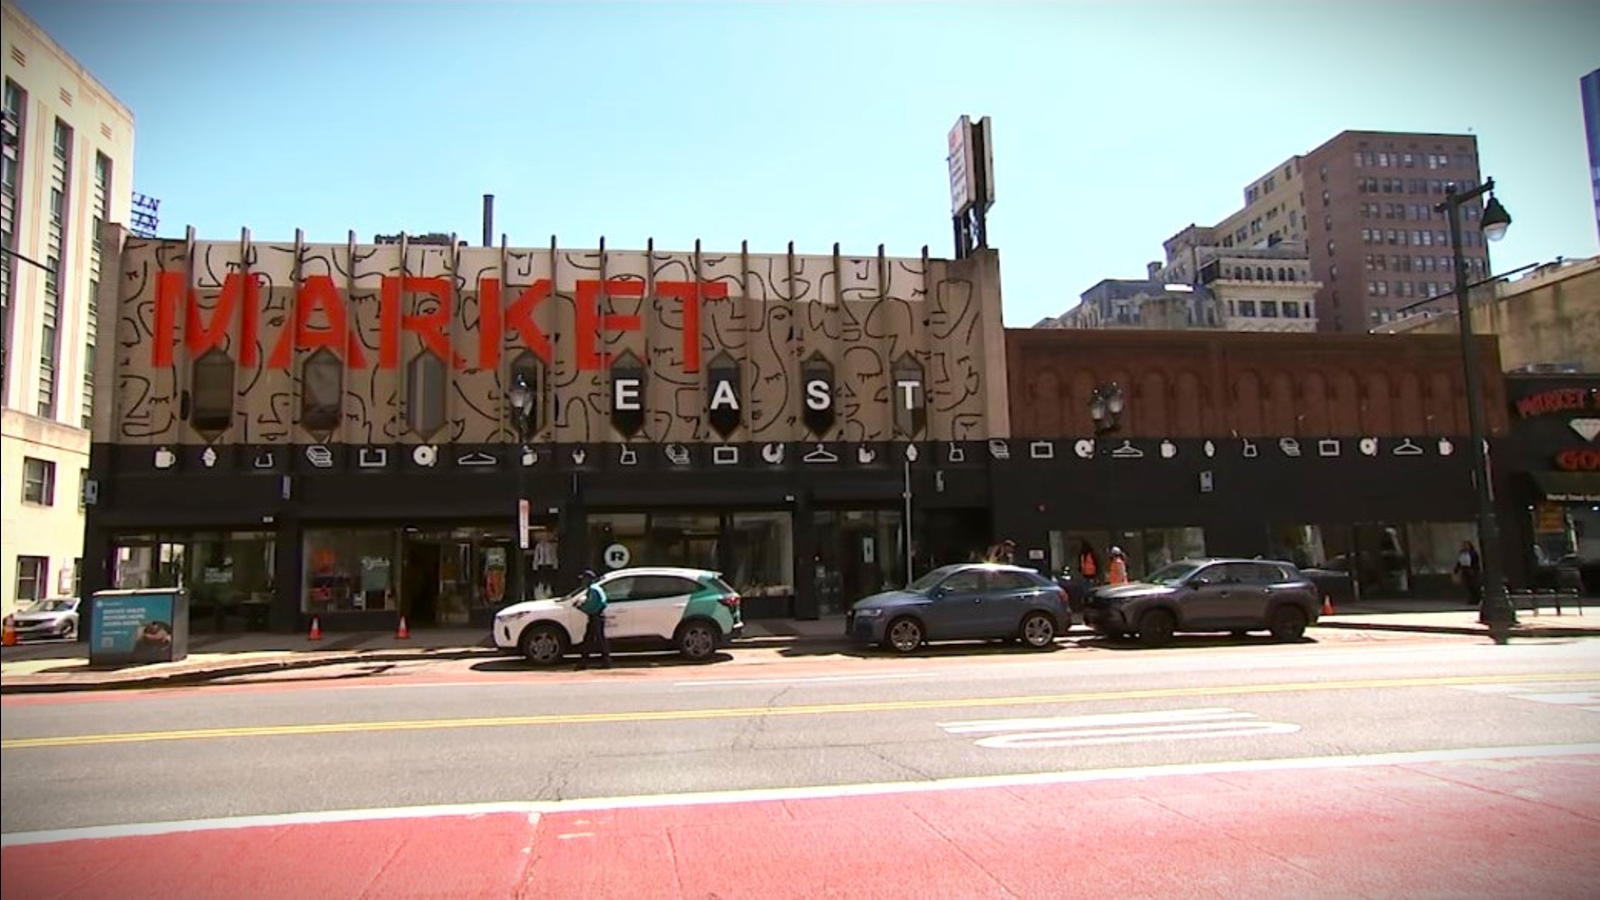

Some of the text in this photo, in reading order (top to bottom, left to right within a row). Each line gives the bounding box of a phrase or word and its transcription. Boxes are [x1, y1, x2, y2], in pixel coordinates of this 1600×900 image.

[151, 270, 728, 374] MARKET
[615, 379, 920, 411] EAST
[1517, 387, 1586, 418] MARKET
[610, 551, 625, 562] R
